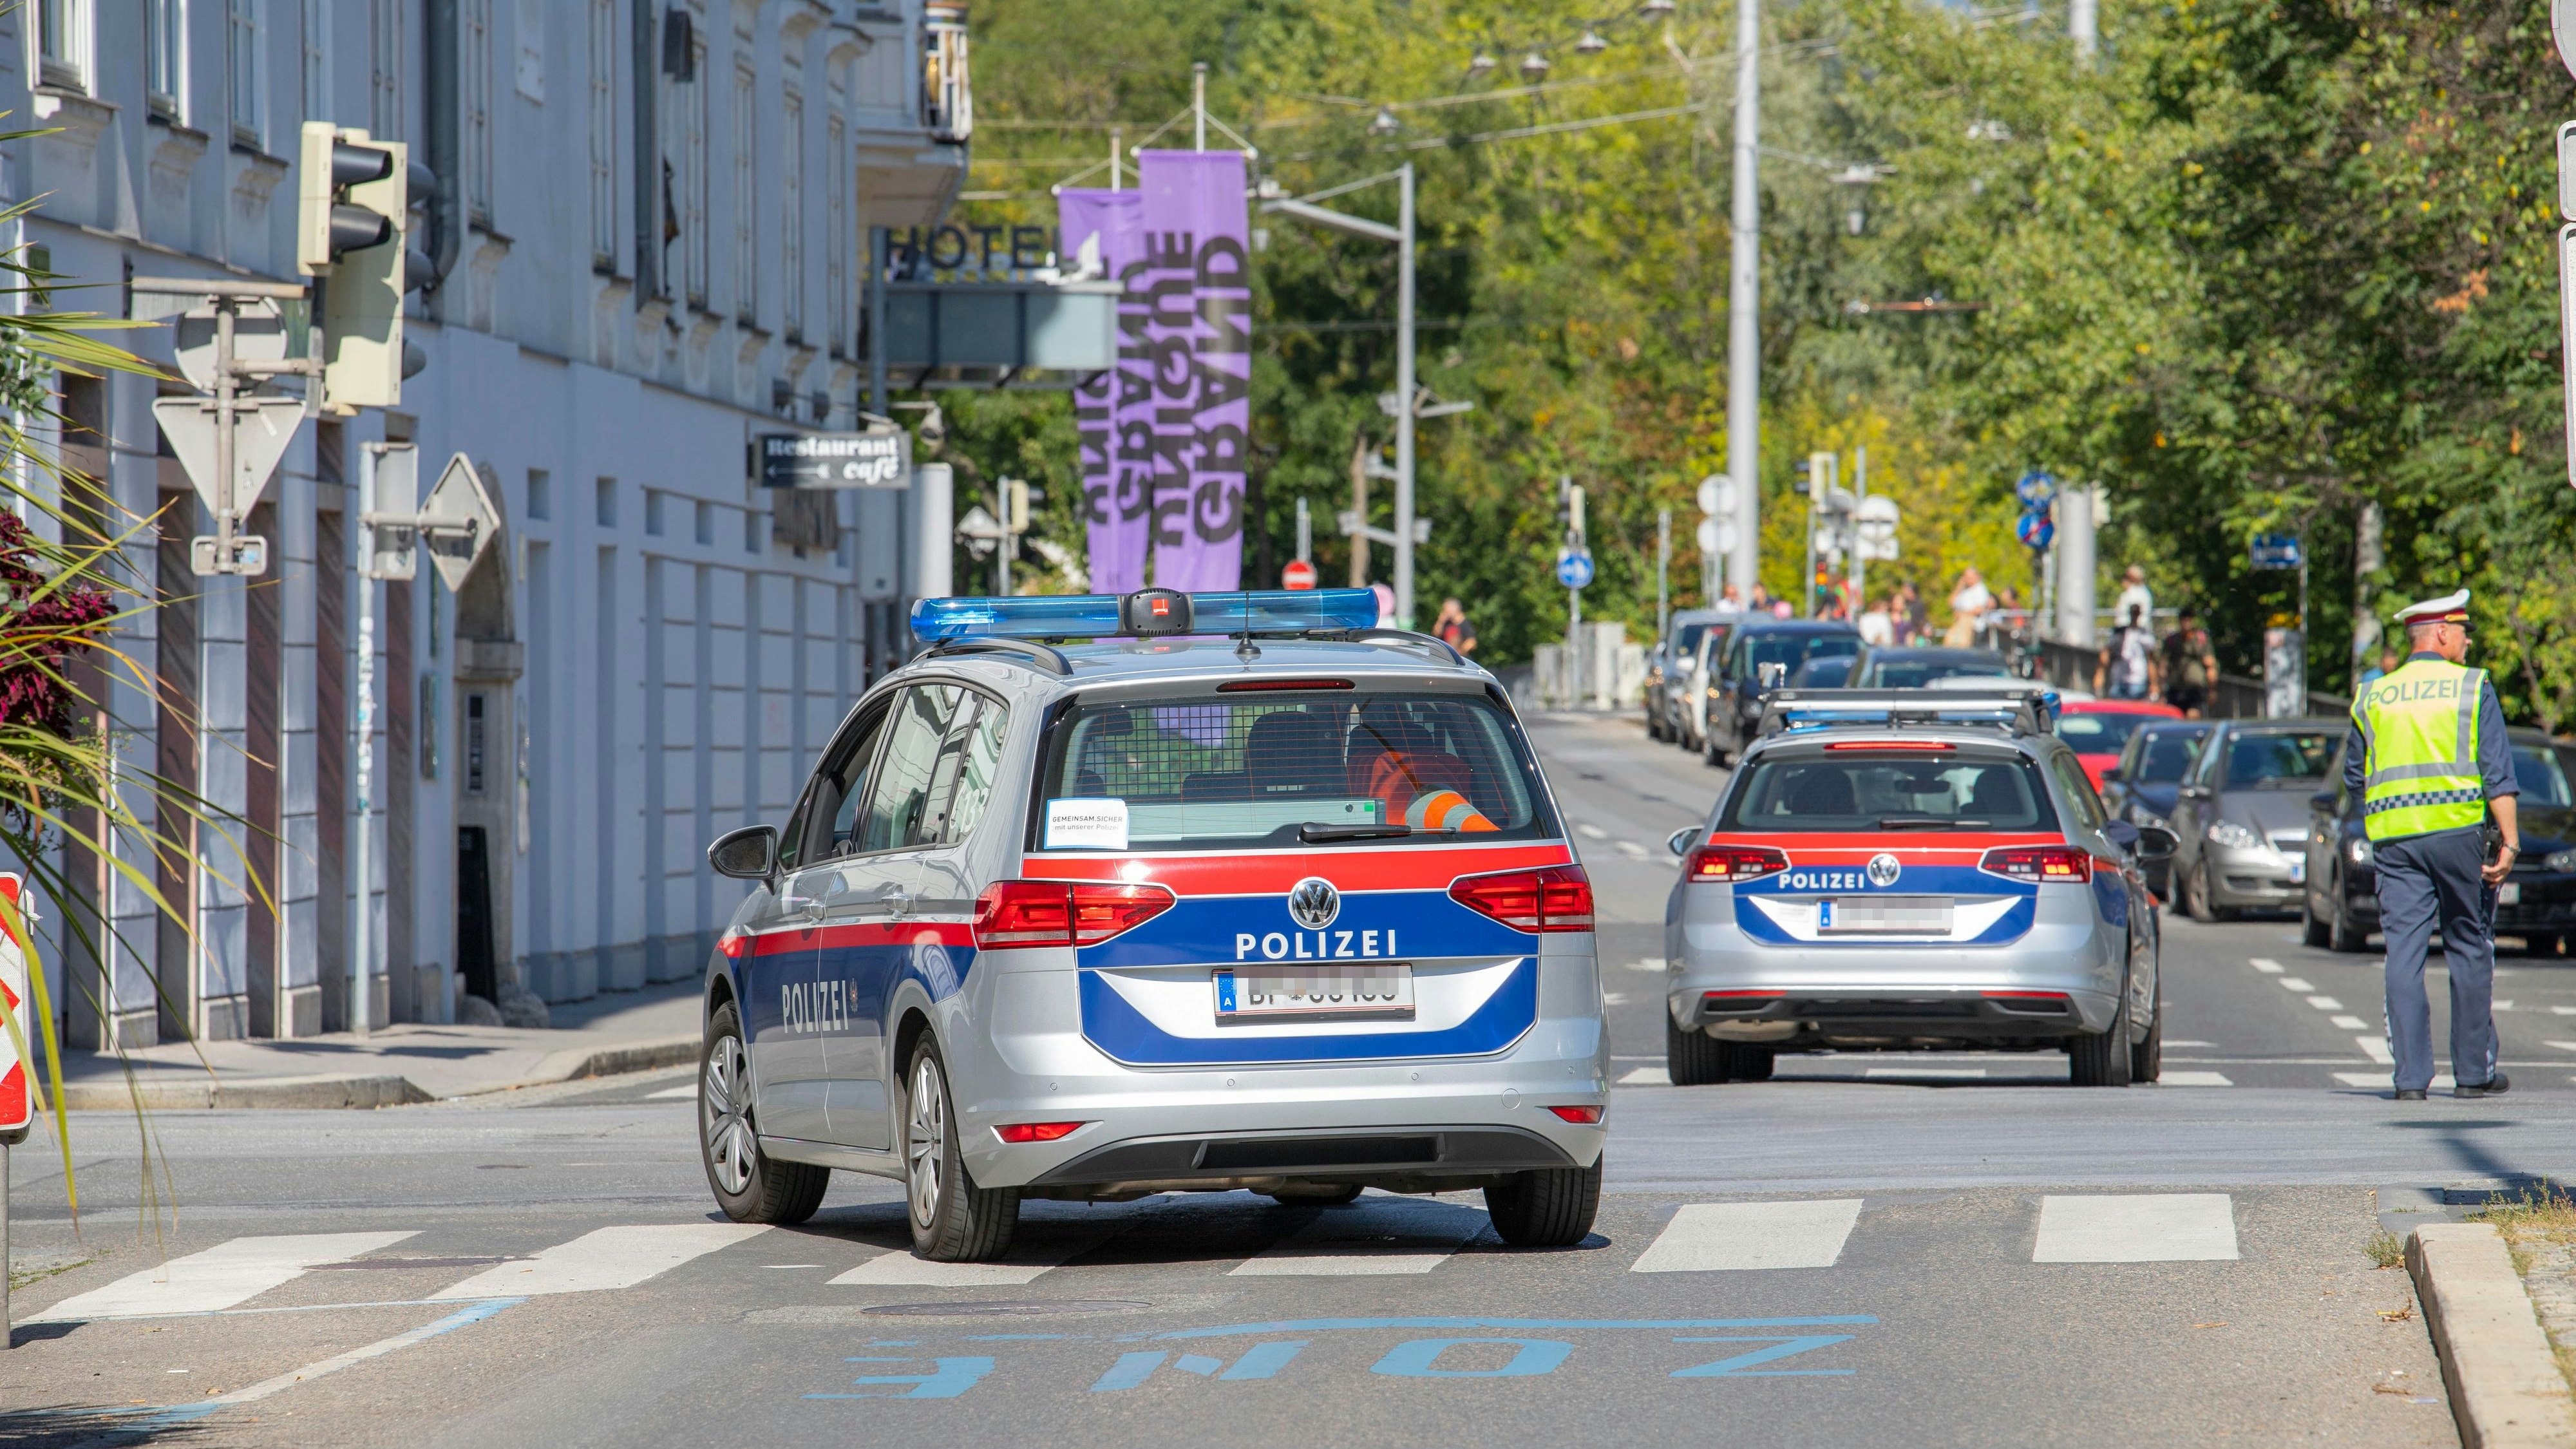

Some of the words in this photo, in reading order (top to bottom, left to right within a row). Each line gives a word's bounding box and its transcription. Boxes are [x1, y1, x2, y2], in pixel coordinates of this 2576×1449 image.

[886, 225, 1082, 270] HOTEL
[767, 437, 898, 457] Restaurant
[843, 455, 899, 486] café
[2367, 679, 2458, 710] POLIZEI
[1779, 873, 1865, 889] POLIZEI
[1236, 929, 1396, 960] POLIZEI
[782, 980, 849, 1034] POLIZEI
